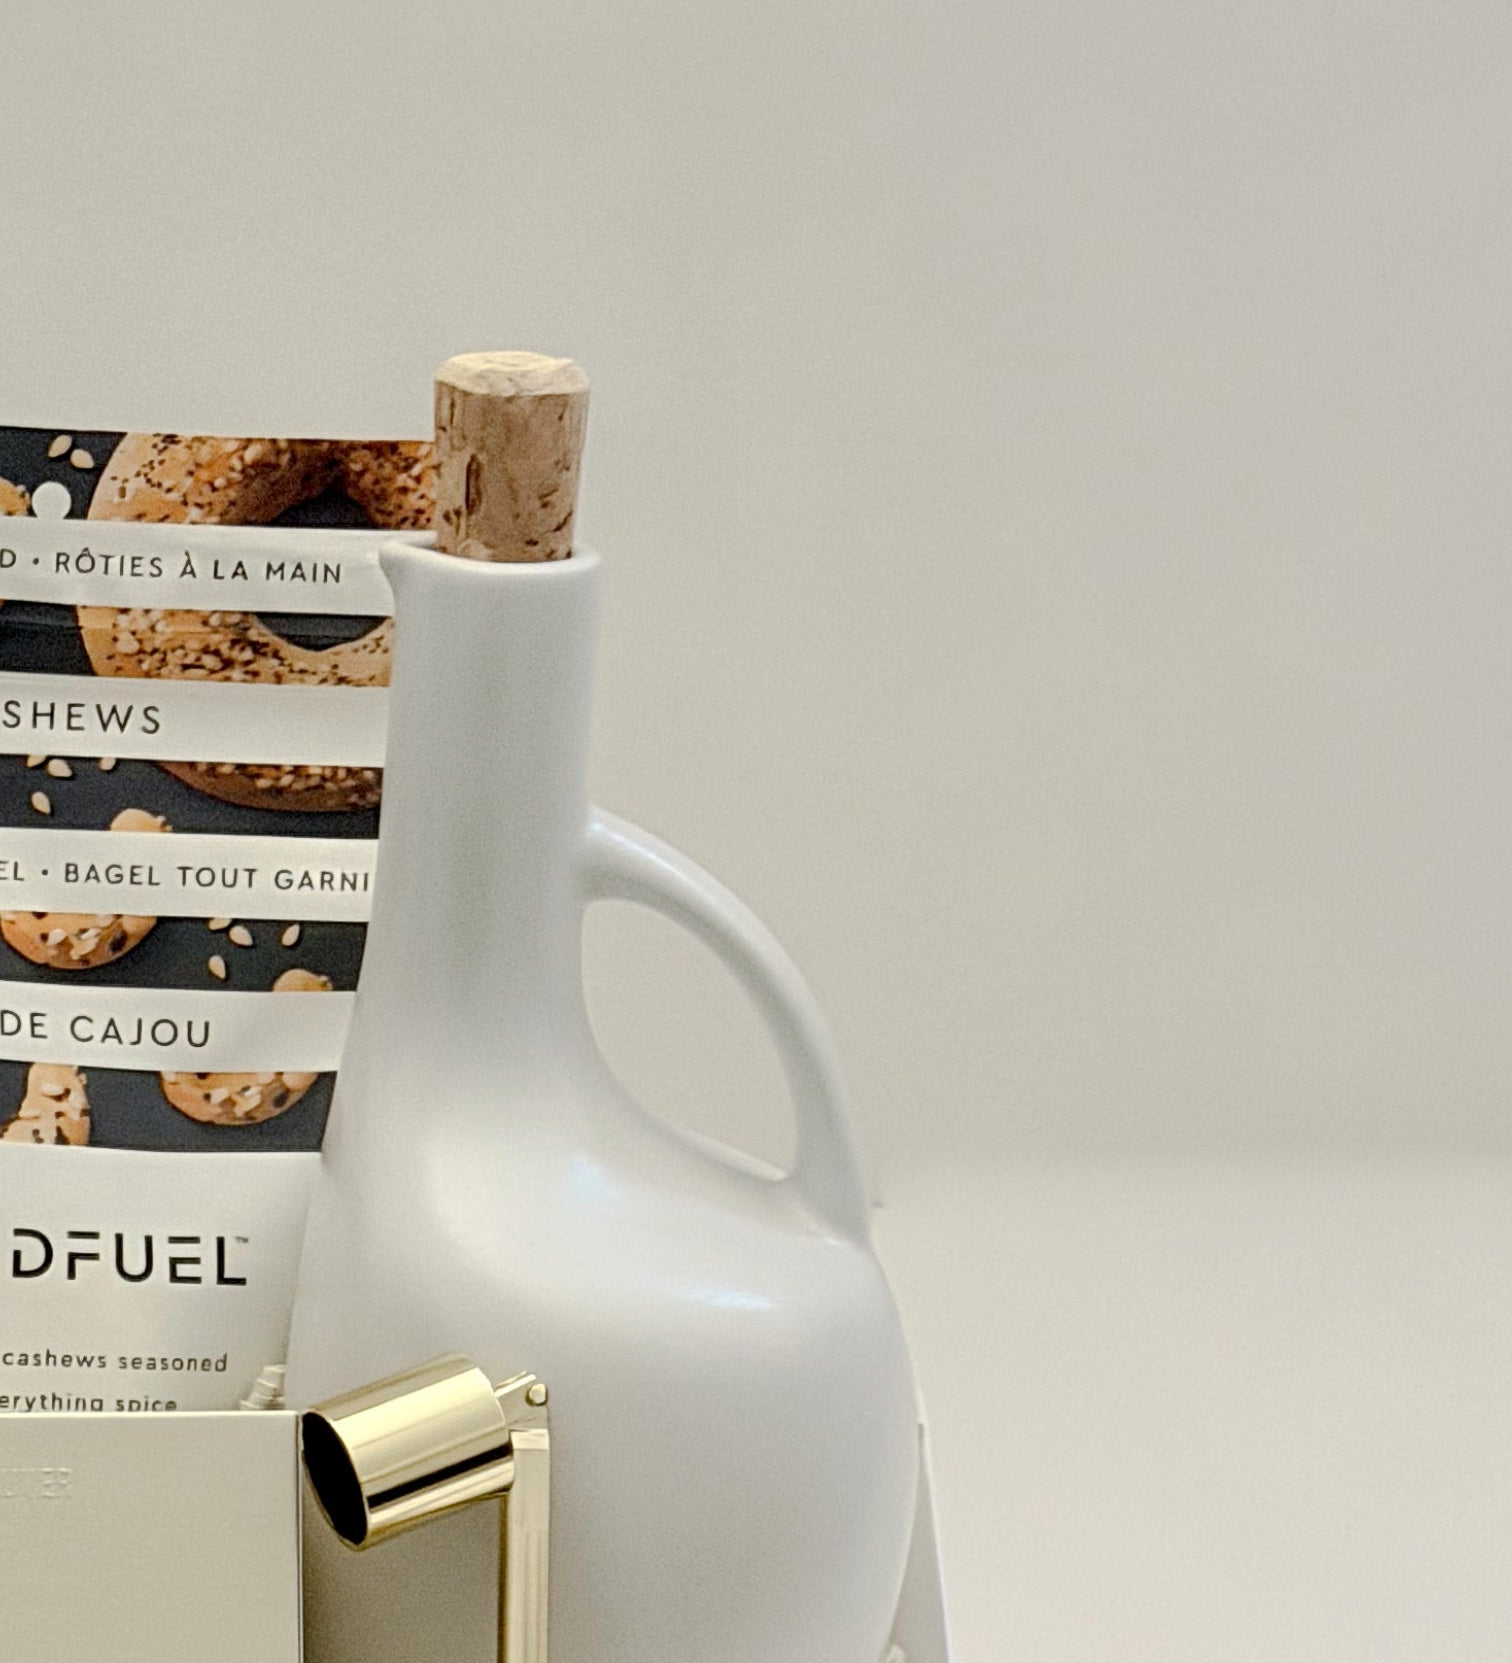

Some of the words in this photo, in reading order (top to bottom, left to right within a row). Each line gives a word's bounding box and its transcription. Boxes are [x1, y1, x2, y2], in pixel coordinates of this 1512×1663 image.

[55, 547, 163, 578] RÔTIES
[179, 550, 197, 579] À
[213, 559, 249, 581] LA
[265, 561, 341, 584] MAIN
[64, 862, 160, 886] BAGEL
[177, 866, 257, 889] TOUT
[274, 869, 369, 892] GARNI
[0, 1009, 48, 1039] DE
[70, 1015, 210, 1048] CAJOU
[2, 1349, 106, 1369] cashews
[119, 1353, 228, 1373] seasoned
